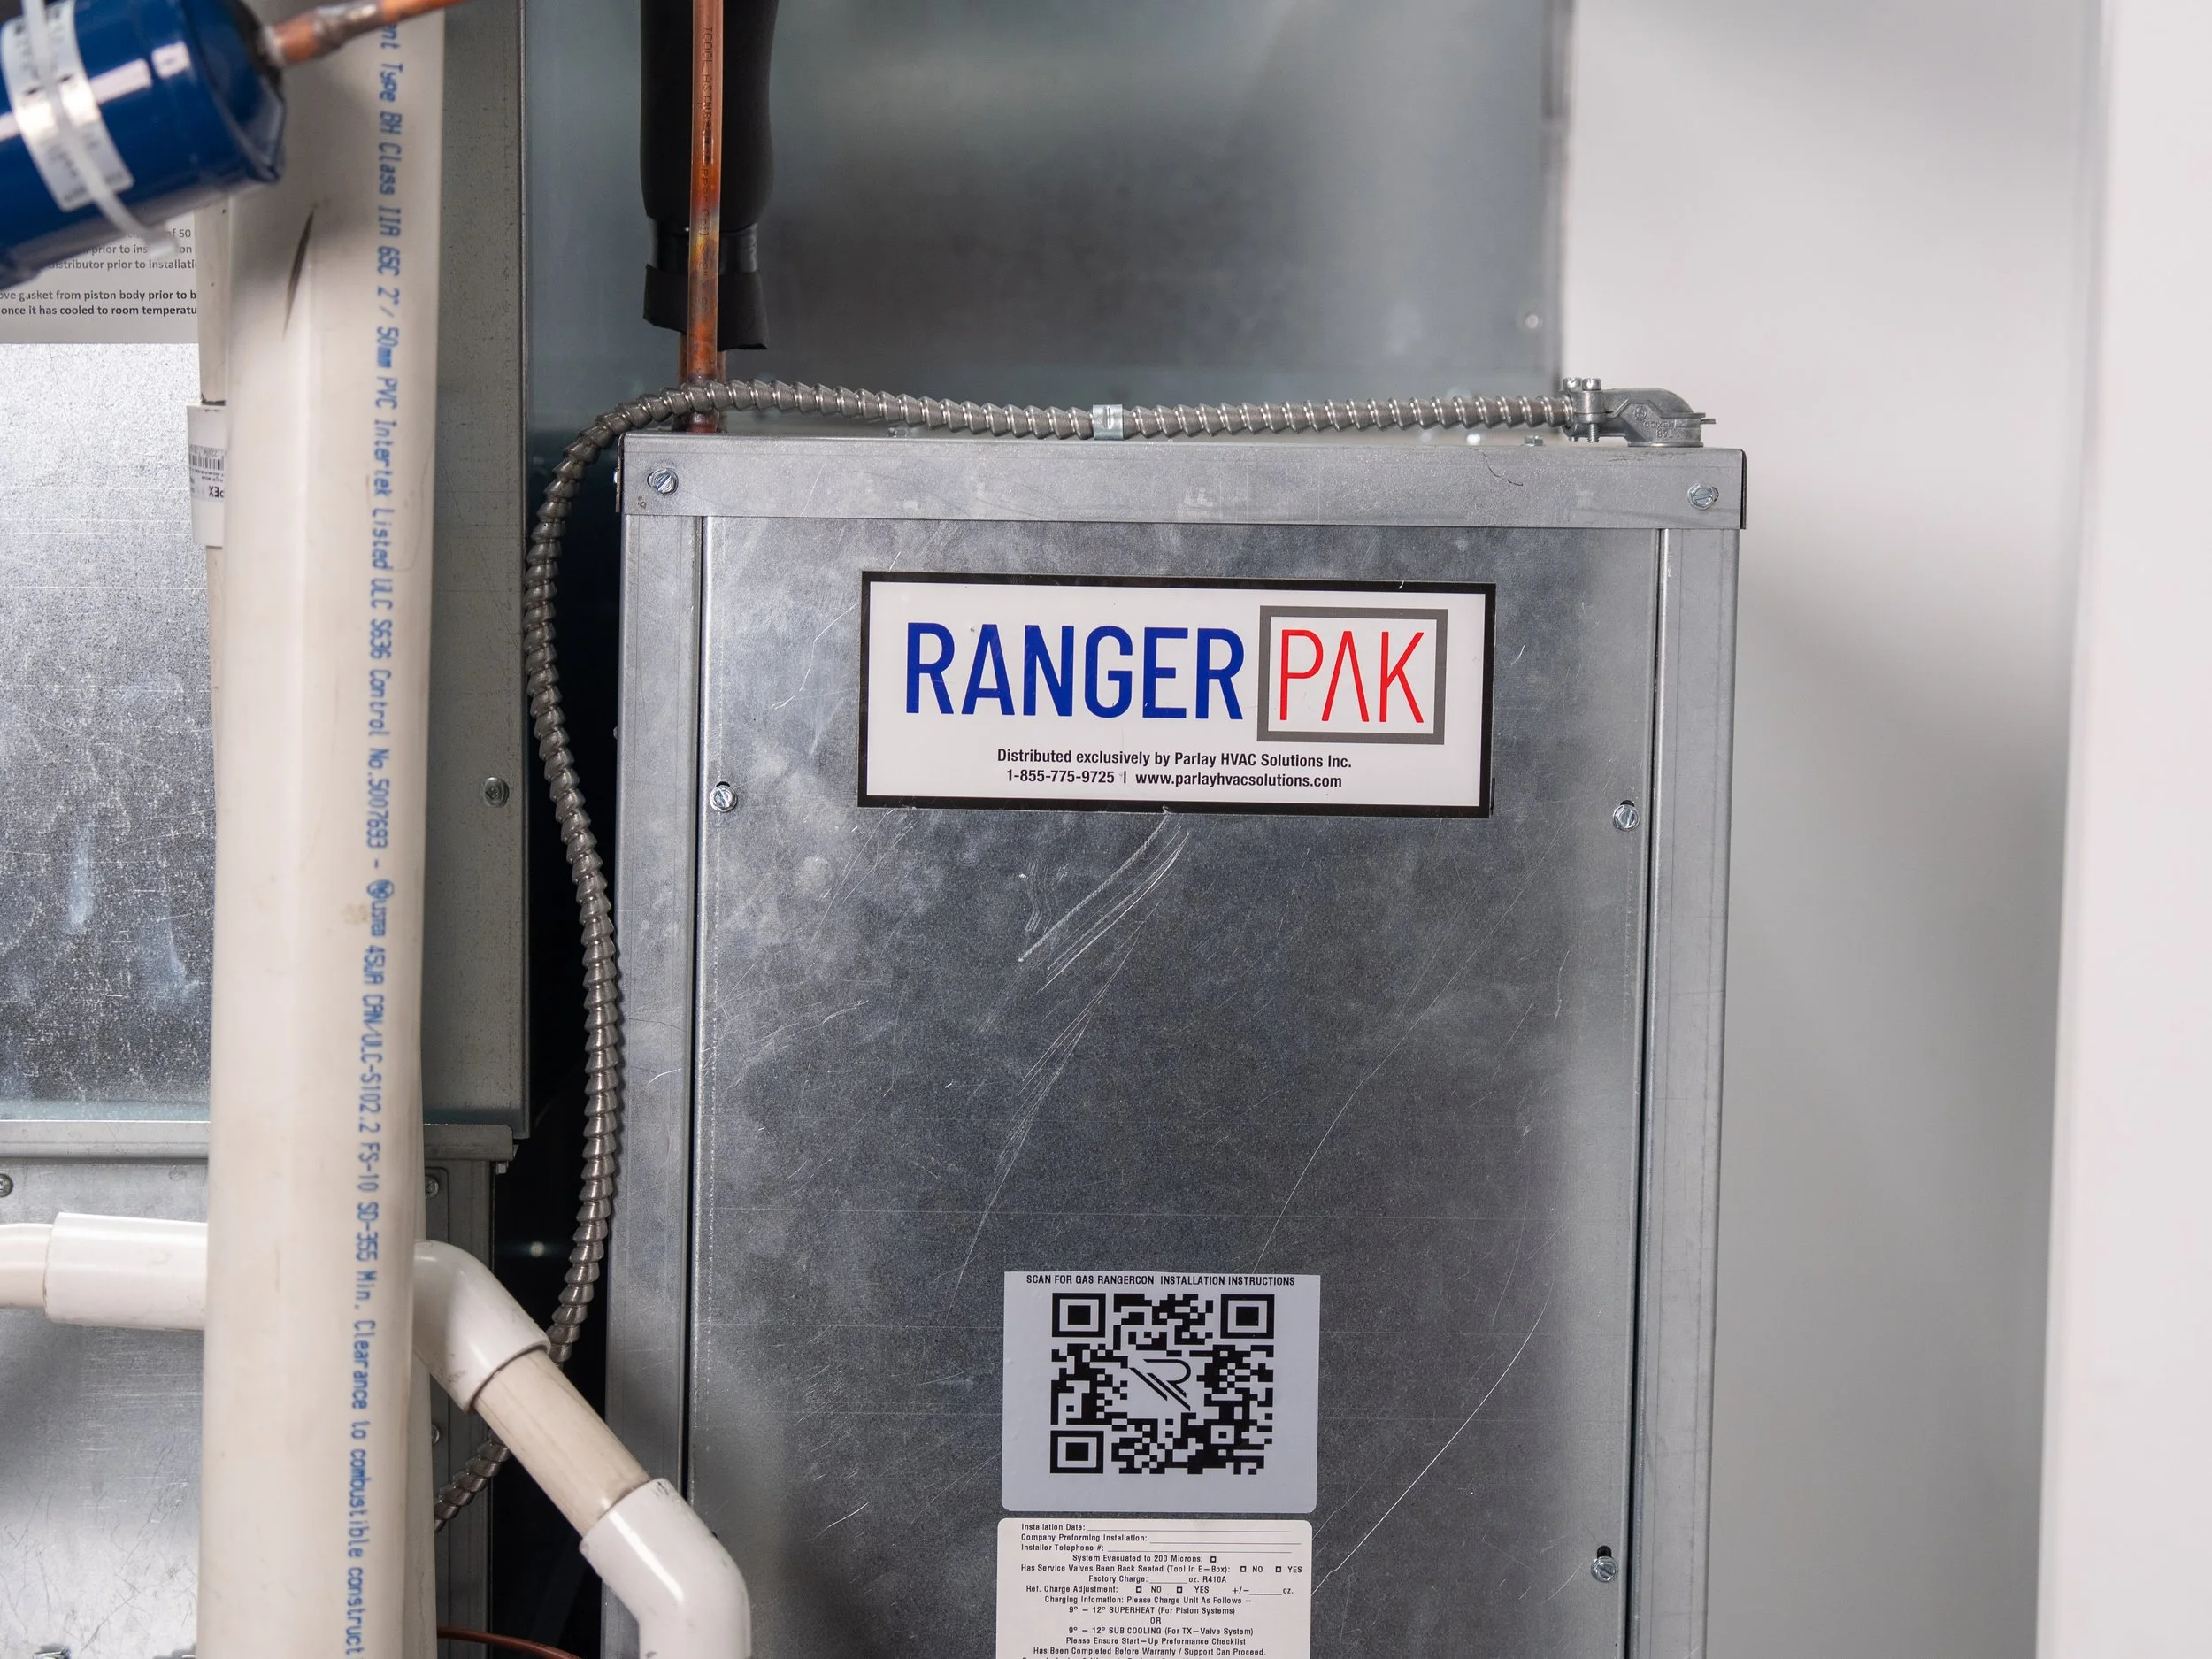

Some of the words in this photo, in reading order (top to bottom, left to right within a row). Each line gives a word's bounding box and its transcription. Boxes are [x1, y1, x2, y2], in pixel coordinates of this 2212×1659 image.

[379, 62, 404, 104] Type
[378, 142, 402, 196] Class
[91, 245, 115, 256] prior
[107, 261, 132, 271] prior
[149, 260, 196, 269] installati
[19, 291, 53, 302] gasket
[57, 290, 81, 299] from
[84, 291, 116, 303] piston
[119, 290, 144, 301] body
[148, 291, 173, 303] prior
[190, 290, 196, 299] b
[28, 306, 35, 315] it
[40, 306, 57, 315] has
[60, 306, 94, 315] cooled
[142, 307, 197, 317] temperatu
[376, 326, 401, 370] 50mm
[374, 377, 398, 409] PVC
[373, 419, 395, 497] Intertek
[372, 507, 394, 571] Listed
[369, 578, 392, 610] ULC
[369, 618, 393, 660] S636
[907, 623, 1244, 719] RANGER
[1280, 630, 1424, 723] PAK
[368, 669, 391, 736] Control
[998, 749, 1071, 762] Distributed
[1077, 751, 1150, 766] exclusively
[1156, 752, 1170, 767] by
[1175, 752, 1216, 767] Parlay
[1221, 753, 1256, 765] HVAC
[1261, 754, 1323, 767] Solutions
[1328, 756, 1351, 767] Inc.
[1007, 769, 1114, 783] 1-855-775-9725
[1136, 772, 1341, 787] www.parlayhvacsolutions.com
[358, 1142, 380, 1191] FS-10
[356, 1270, 378, 1310] Min.
[1055, 1275, 1071, 1284] FOR
[1161, 1276, 1225, 1285] INSTALLATION
[352, 1319, 376, 1411] Clearance
[351, 1421, 370, 1441] to
[349, 1448, 371, 1558] combustible
[346, 1566, 365, 1656] construct
[1154, 1596, 1180, 1605] Charge
